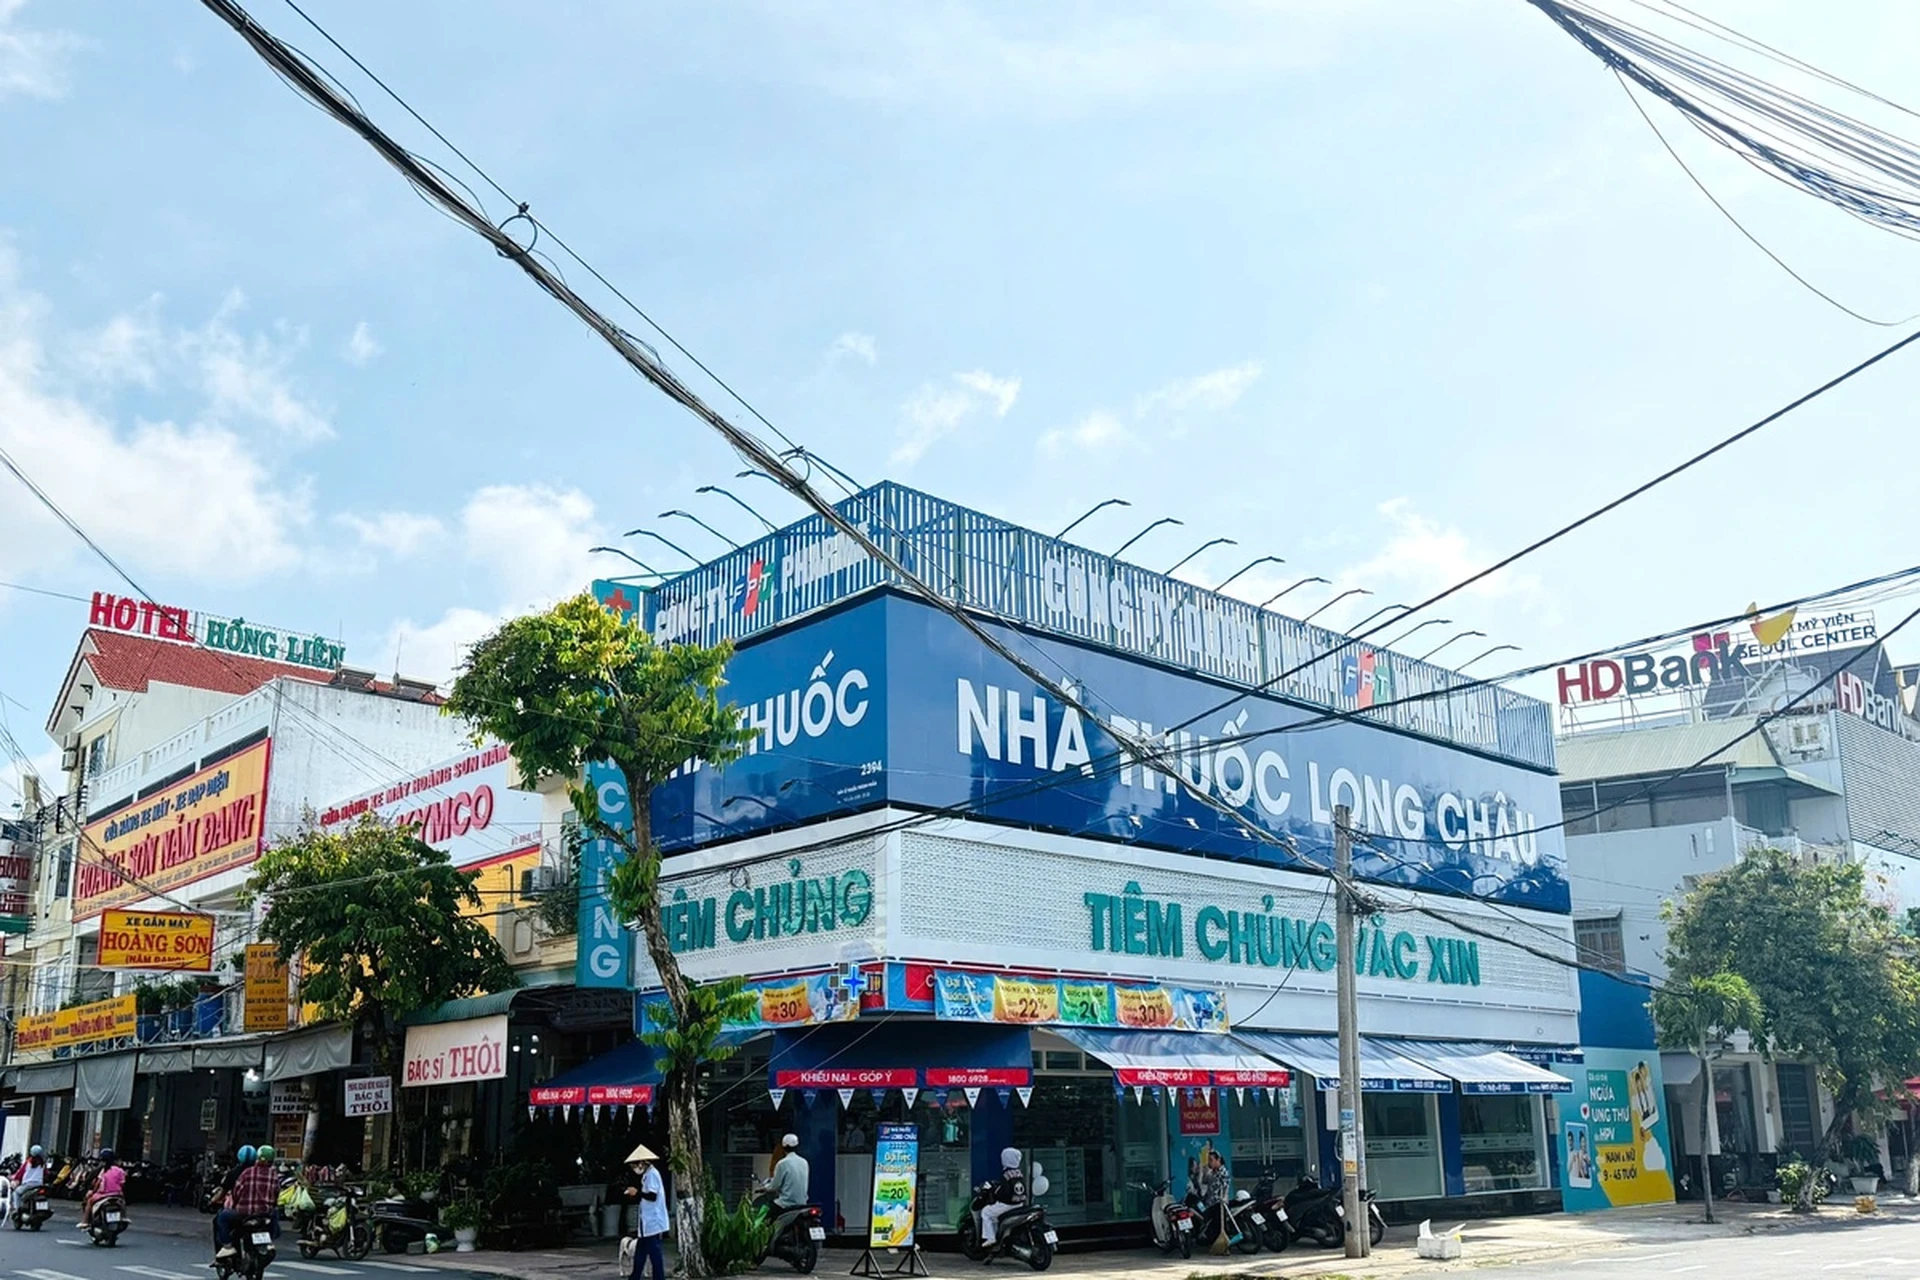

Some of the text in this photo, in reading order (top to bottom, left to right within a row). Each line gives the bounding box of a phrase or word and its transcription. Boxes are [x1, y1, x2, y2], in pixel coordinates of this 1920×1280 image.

[90, 591, 195, 642] HOTEL
[655, 595, 701, 645] CÔNG
[706, 584, 729, 623] TY
[732, 564, 774, 609] FPT
[1044, 553, 1130, 632] CÔNG
[1139, 586, 1176, 645] TY
[1343, 657, 1390, 705] FPT
[1797, 612, 1855, 631] MỸ VIỆN
[205, 617, 346, 670] HỒNG LIÊN
[1801, 625, 1878, 648] CENTER
[1557, 641, 1750, 705] HDBank
[733, 649, 869, 759] THUỐC
[1834, 671, 1905, 738] HDBank
[861, 760, 882, 776] 2394
[957, 675, 1537, 866] NHÀ THUỐC LONG CHÂU
[412, 769, 452, 795] HOÀNG
[200, 794, 256, 856] ĐANG
[659, 859, 873, 955] IÊM CHỦNG
[126, 917, 141, 926] XE
[1084, 880, 1184, 958] TIÊM
[1195, 894, 1338, 972] CHỦNG
[1426, 934, 1481, 986] XIN
[103, 928, 210, 955] HOÀNG SƠN
[1018, 997, 1048, 1018] 22%
[1138, 1003, 1165, 1023] 30%
[407, 1036, 503, 1082] BÁC SĨ THÔI
[801, 1070, 830, 1083] KHIẾU
[831, 1072, 850, 1086] NẠI
[858, 1070, 883, 1083] GÓP
[885, 1069, 893, 1082] Ý
[948, 1074, 967, 1083] 1800
[350, 1099, 390, 1115] THÔI
[355, 1091, 373, 1101] BÁC
[1591, 1107, 1611, 1122] UNG
[1605, 1151, 1621, 1163] NAM
[1602, 1169, 1608, 1181] 9
[1613, 1168, 1622, 1180] 45
